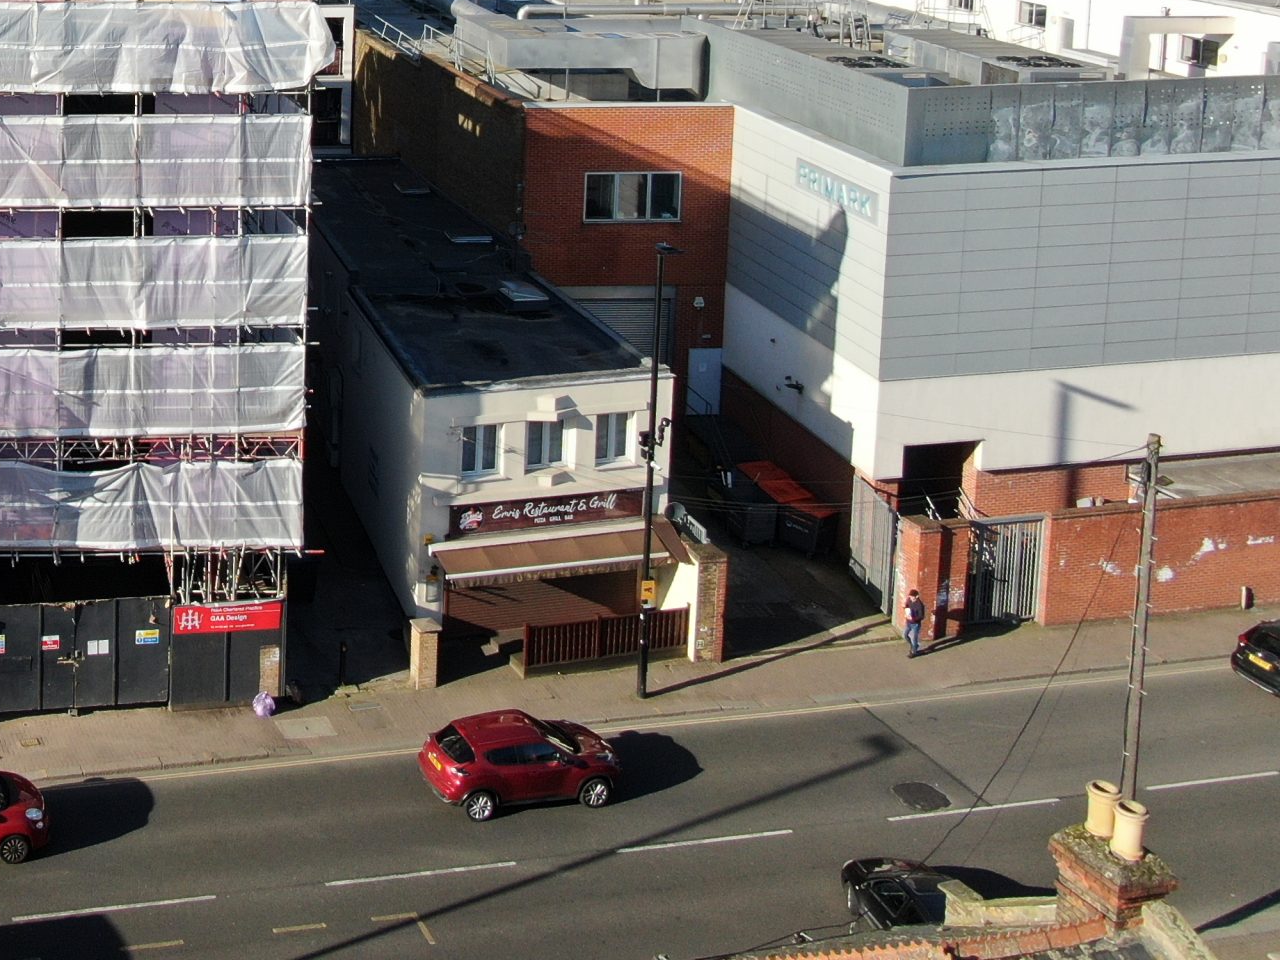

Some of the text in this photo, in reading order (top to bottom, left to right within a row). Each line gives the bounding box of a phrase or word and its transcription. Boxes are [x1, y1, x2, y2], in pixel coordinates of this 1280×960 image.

[799, 162, 872, 217] PRIMARK
[523, 499, 578, 518] Restaurant
[577, 499, 587, 511] &
[589, 493, 617, 510] Grill
[226, 613, 248, 622] Design
